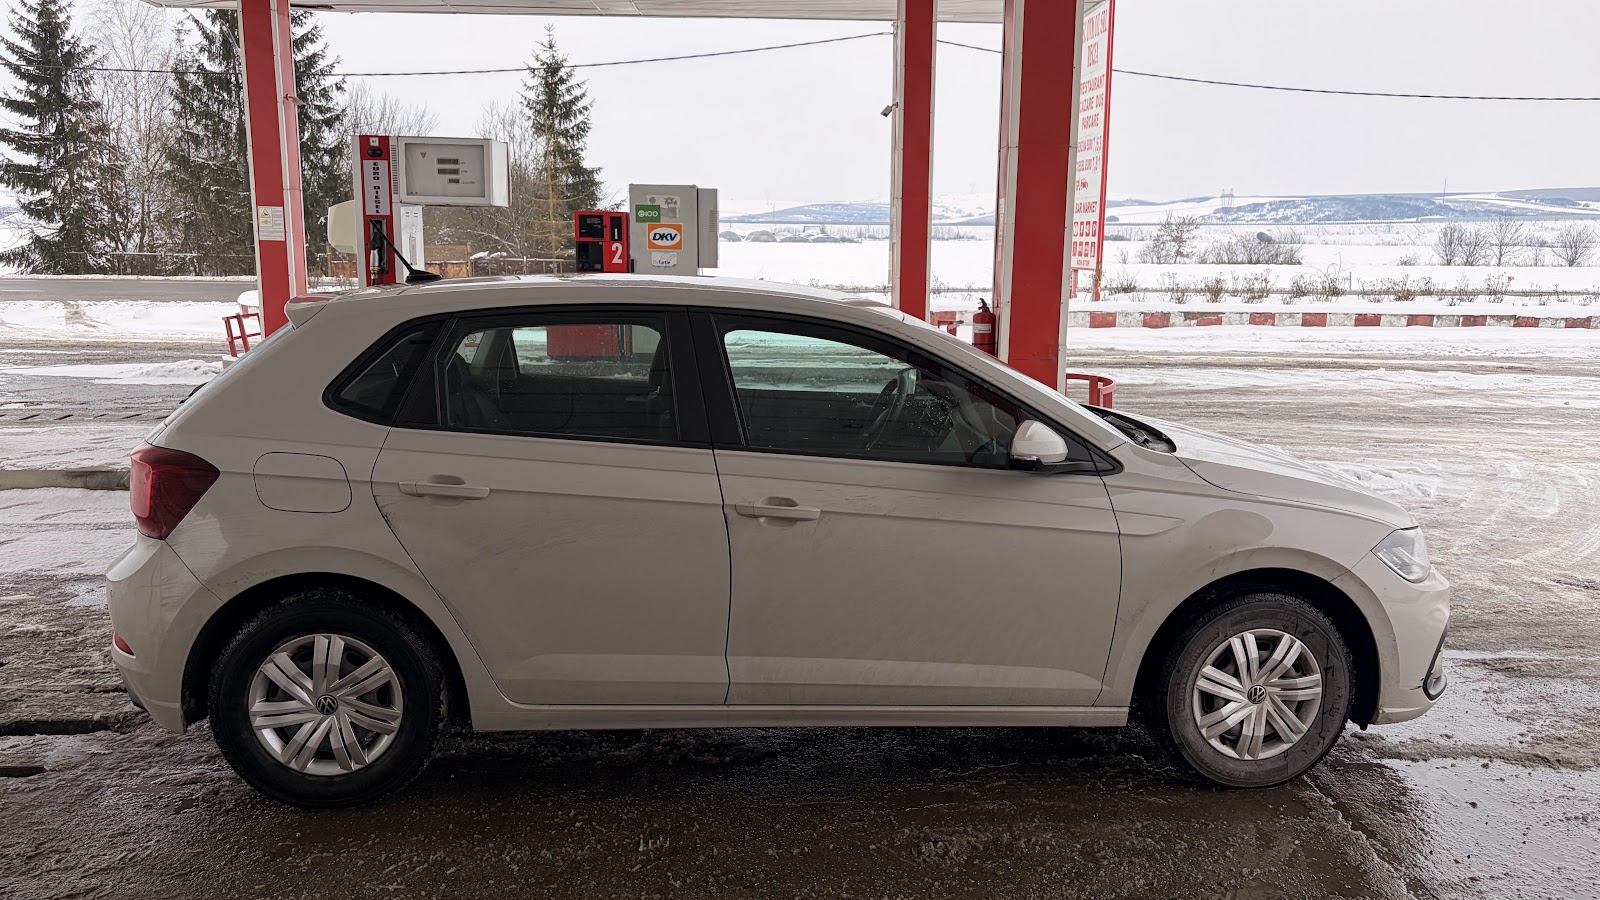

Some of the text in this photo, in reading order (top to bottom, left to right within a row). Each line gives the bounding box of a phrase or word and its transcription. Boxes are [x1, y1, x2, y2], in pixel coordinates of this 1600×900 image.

[373, 186, 381, 213] DIESEL
[652, 232, 678, 241] DKV
[611, 242, 623, 264] 2
